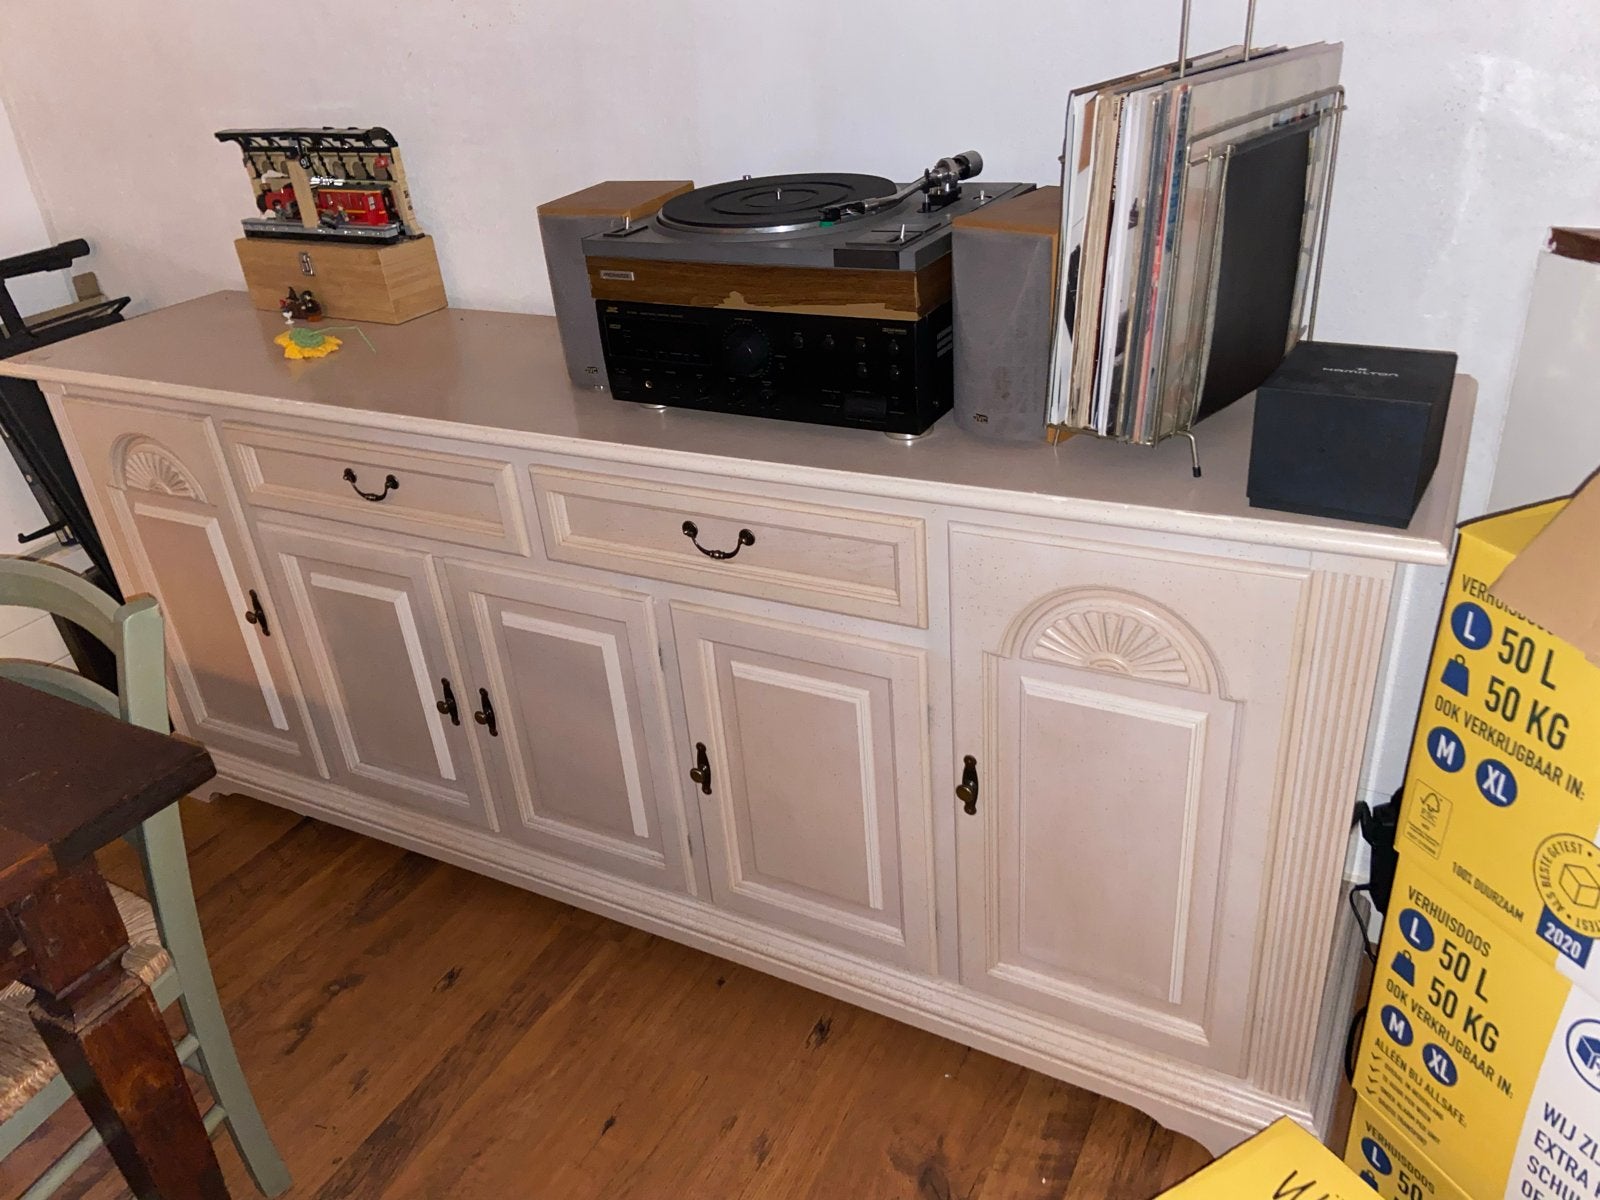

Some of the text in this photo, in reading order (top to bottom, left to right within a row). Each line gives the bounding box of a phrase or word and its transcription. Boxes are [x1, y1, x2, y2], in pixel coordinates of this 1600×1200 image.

[1463, 610, 1476, 642] L
[1497, 627, 1557, 691] 50 L
[1484, 677, 1570, 751] 50 KG
[1434, 694, 1585, 801] OOK VERKRIJGBAAR IN:
[1436, 735, 1456, 766] M
[1481, 765, 1509, 803] XL
[1539, 841, 1584, 912] ALS BESTE GETEST
[1408, 886, 1491, 957] VERHUISDOOS
[1473, 878, 1525, 922] DUURZAAM
[1409, 918, 1421, 944] L
[1544, 921, 1582, 959] 2020
[1438, 939, 1492, 1003] 50 L
[1386, 978, 1408, 1006] OOK
[1410, 997, 1495, 1082] VERKRIJGBAAR
[1389, 1011, 1405, 1040] M
[1427, 978, 1499, 1053] 50 KG
[1428, 1048, 1451, 1084] XL
[1543, 1101, 1577, 1141] WIJ
[1365, 1122, 1435, 1195] VERHUISDOOS
[1371, 1146, 1381, 1168] L
[1534, 1129, 1589, 1190] EXTRA
[1397, 1170, 1423, 1200] 50
